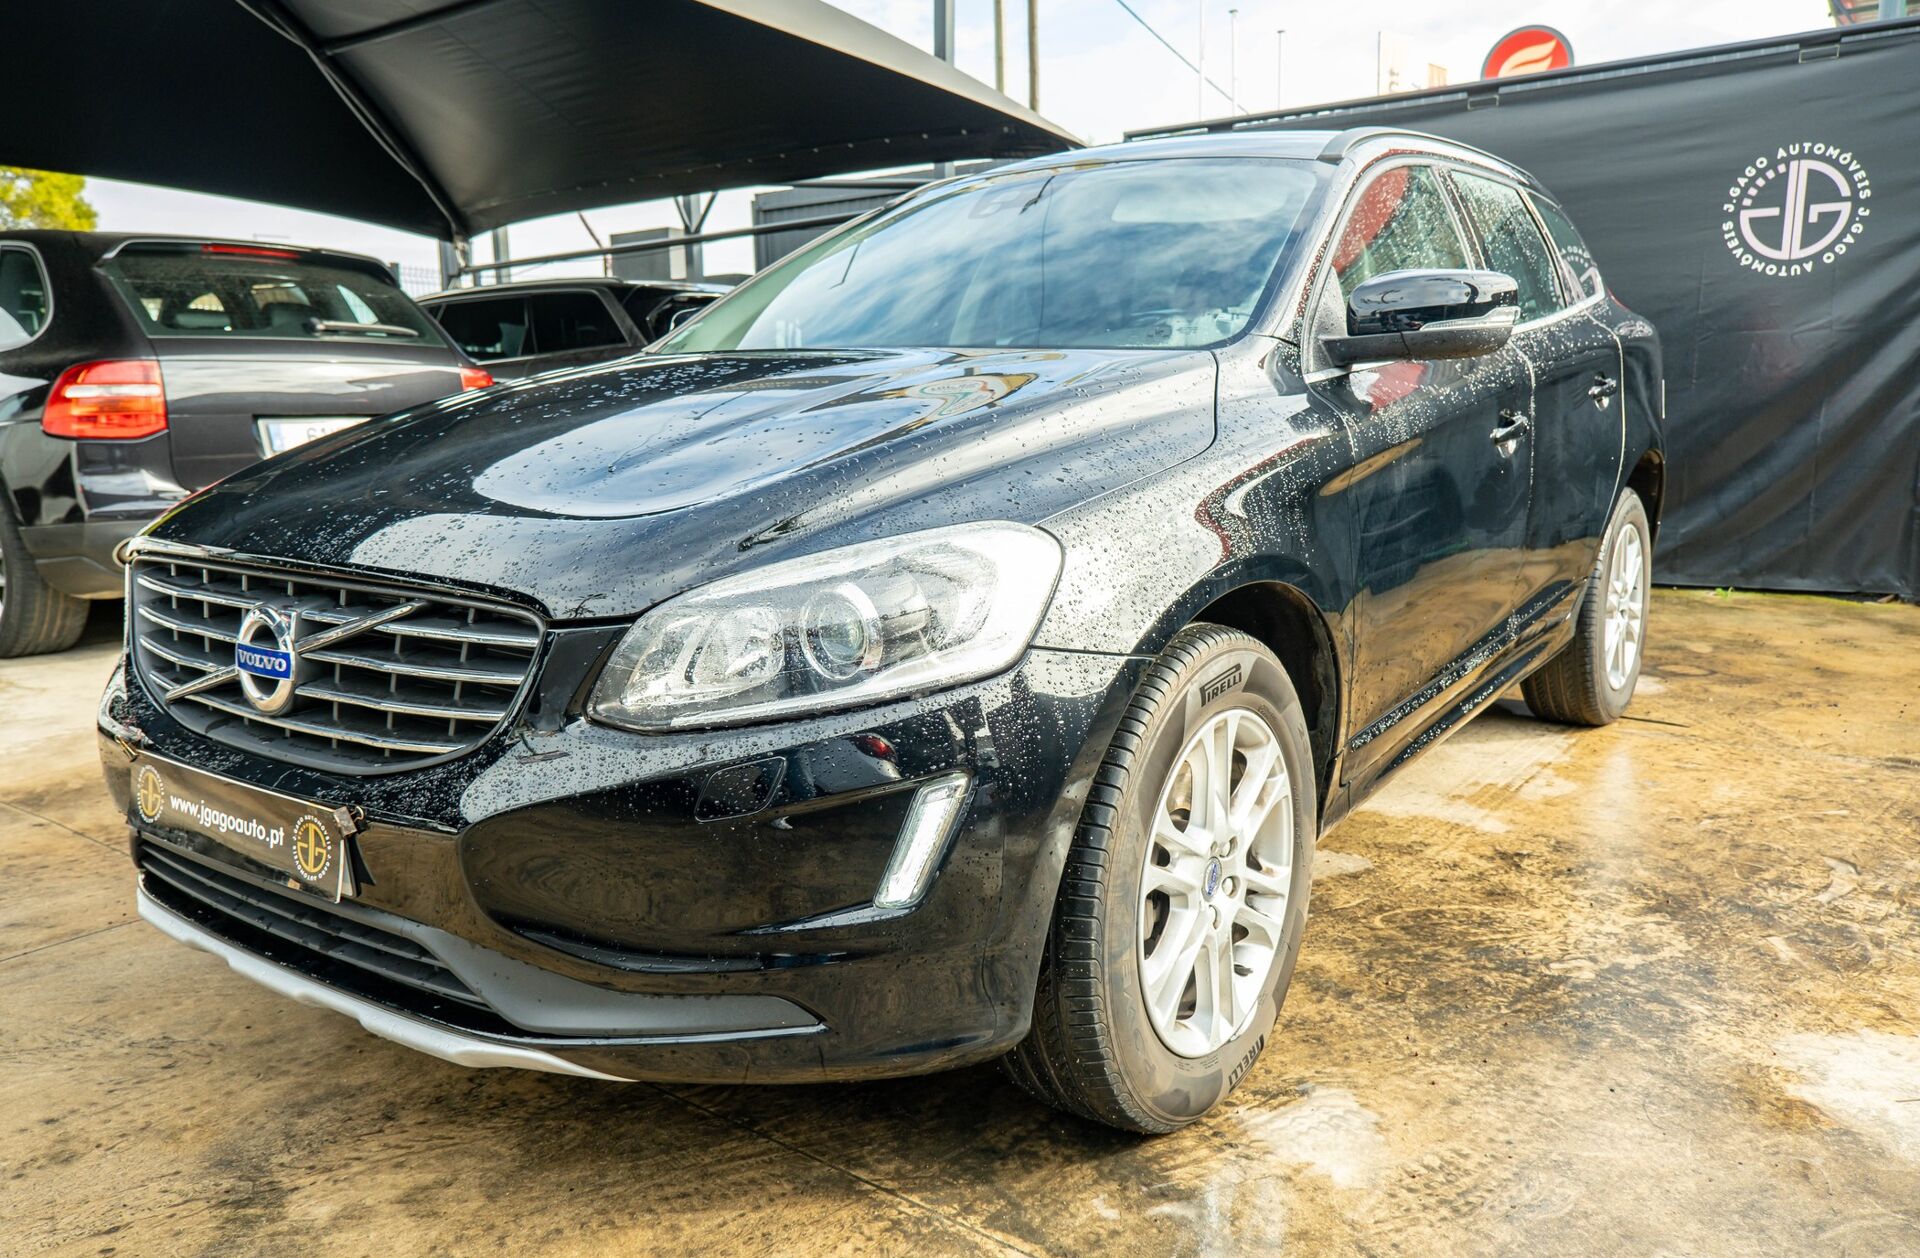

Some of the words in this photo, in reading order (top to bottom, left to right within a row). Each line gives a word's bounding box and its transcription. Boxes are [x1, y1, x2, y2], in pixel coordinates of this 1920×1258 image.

[1723, 157, 1768, 213] J.GAGO
[1776, 142, 1872, 200] AUTOMÓVEIS
[1722, 220, 1813, 277] AUTOMÓVEIS
[238, 649, 287, 672] VOLVO
[1199, 663, 1242, 707] PIRELLI
[170, 794, 285, 848] www.jgagoauto.pt
[1228, 1034, 1265, 1093] PIRELLI
